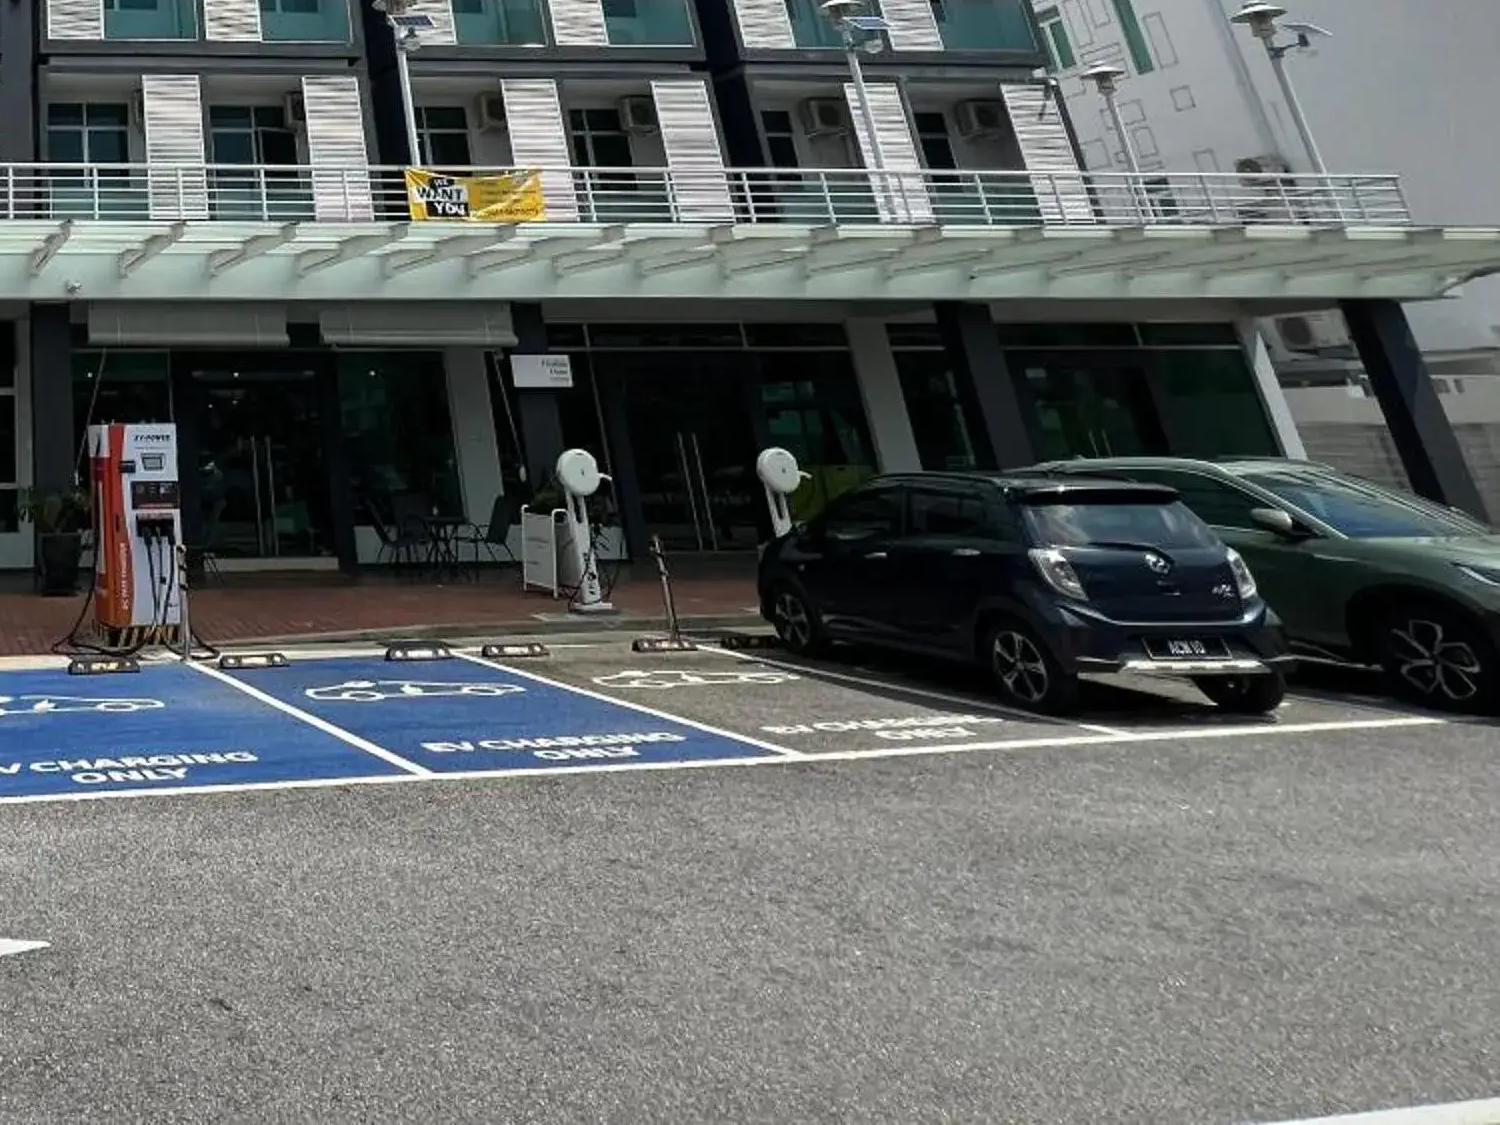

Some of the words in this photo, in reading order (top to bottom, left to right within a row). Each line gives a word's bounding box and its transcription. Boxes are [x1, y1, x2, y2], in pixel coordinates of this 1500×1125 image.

[417, 188, 464, 202] WANT
[433, 202, 466, 216] YOU
[420, 741, 475, 752] EV
[479, 732, 687, 750] CHARGING
[533, 746, 641, 761] ONLY
[29, 751, 258, 773] CHARGING
[71, 767, 188, 784] ONLY
